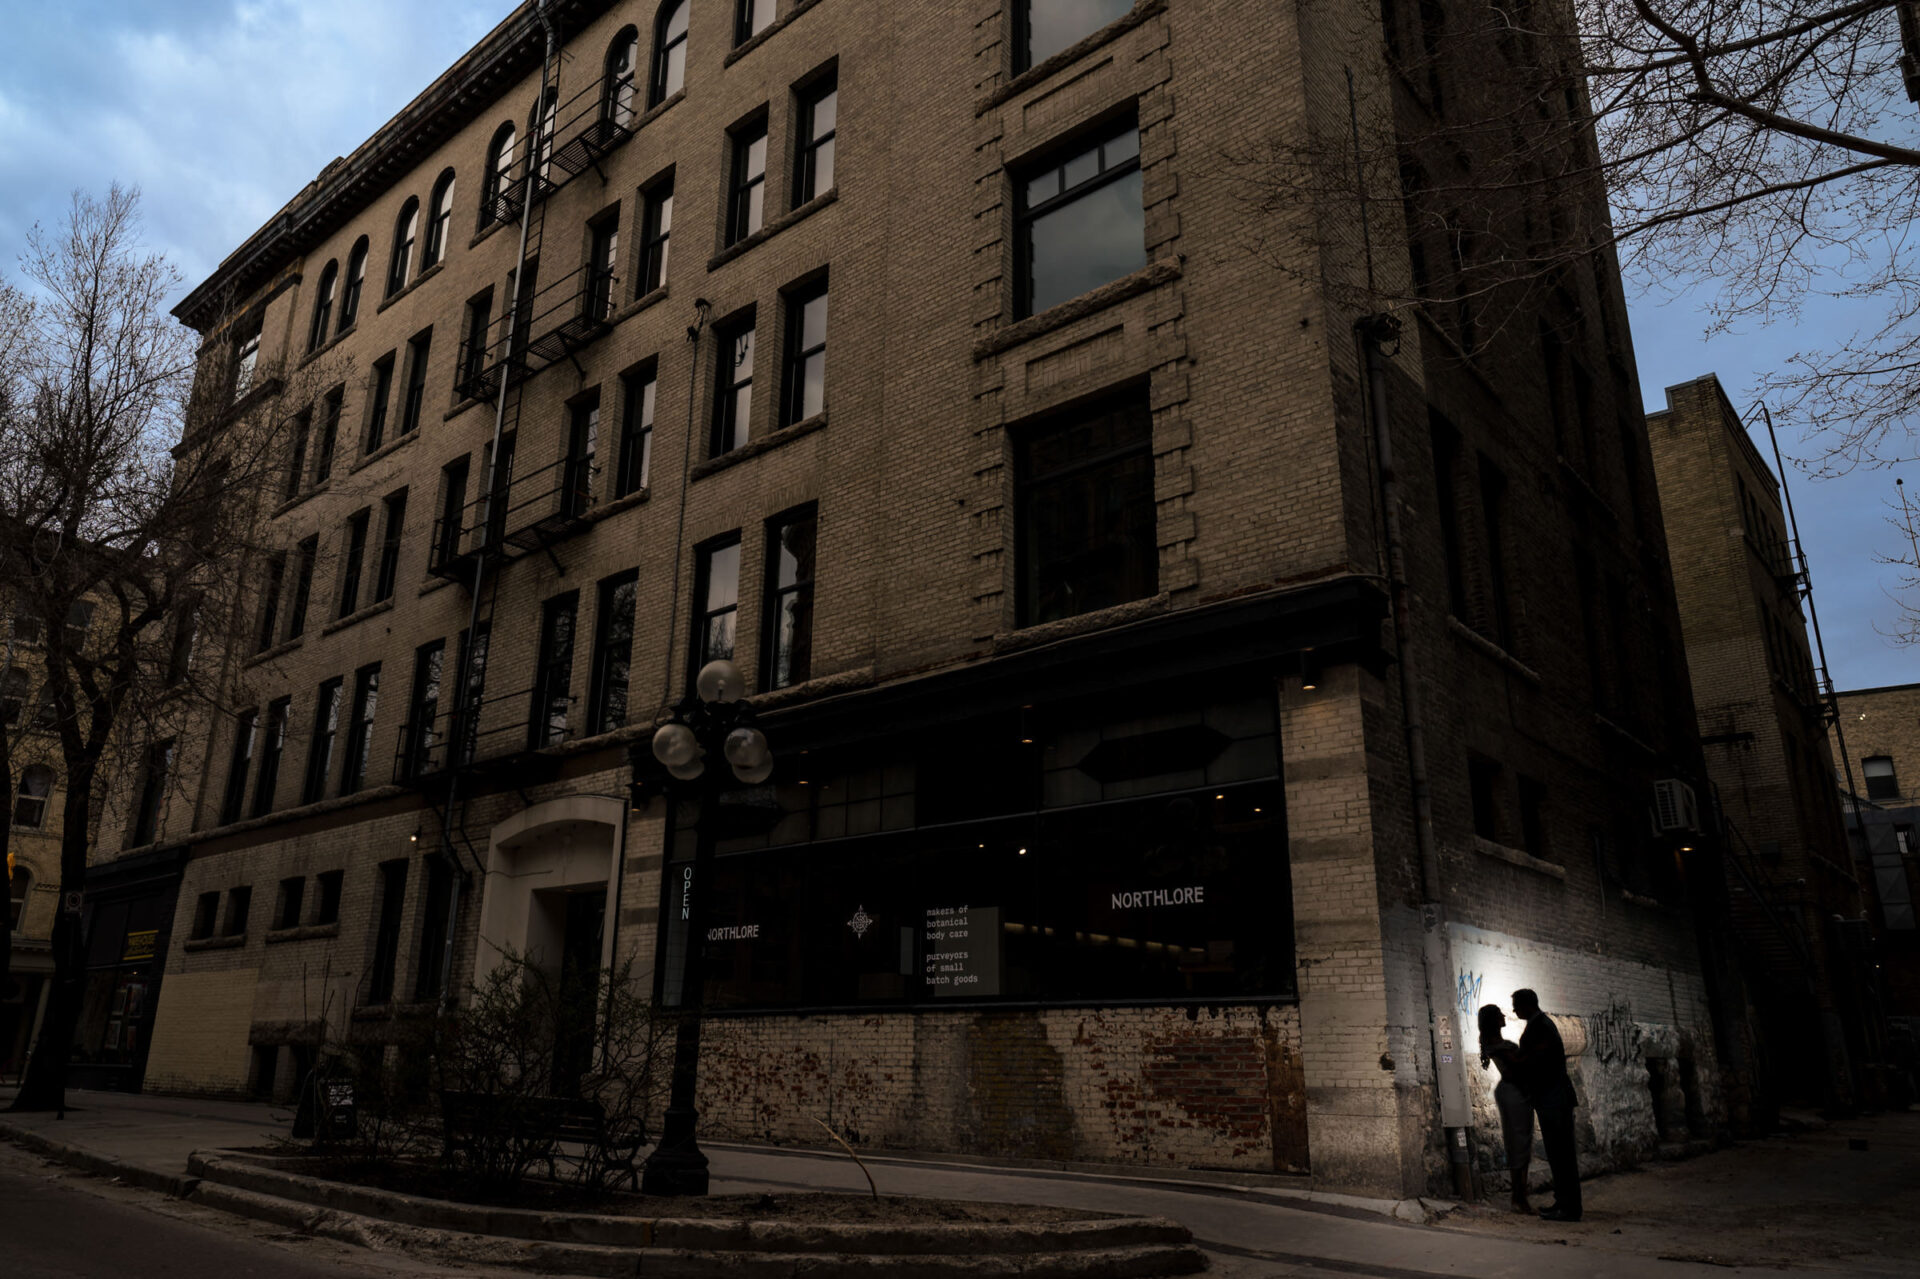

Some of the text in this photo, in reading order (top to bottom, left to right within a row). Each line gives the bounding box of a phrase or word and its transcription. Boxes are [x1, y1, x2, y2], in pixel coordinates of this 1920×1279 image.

[682, 867, 692, 920] OPEN
[1111, 886, 1204, 910] NORTHLORE
[926, 904, 968, 916] makers of
[926, 917, 968, 928] botanical
[926, 930, 969, 940] body care
[926, 952, 969, 963] purveyors
[926, 962, 964, 973] of small
[926, 975, 978, 986] batch goods
